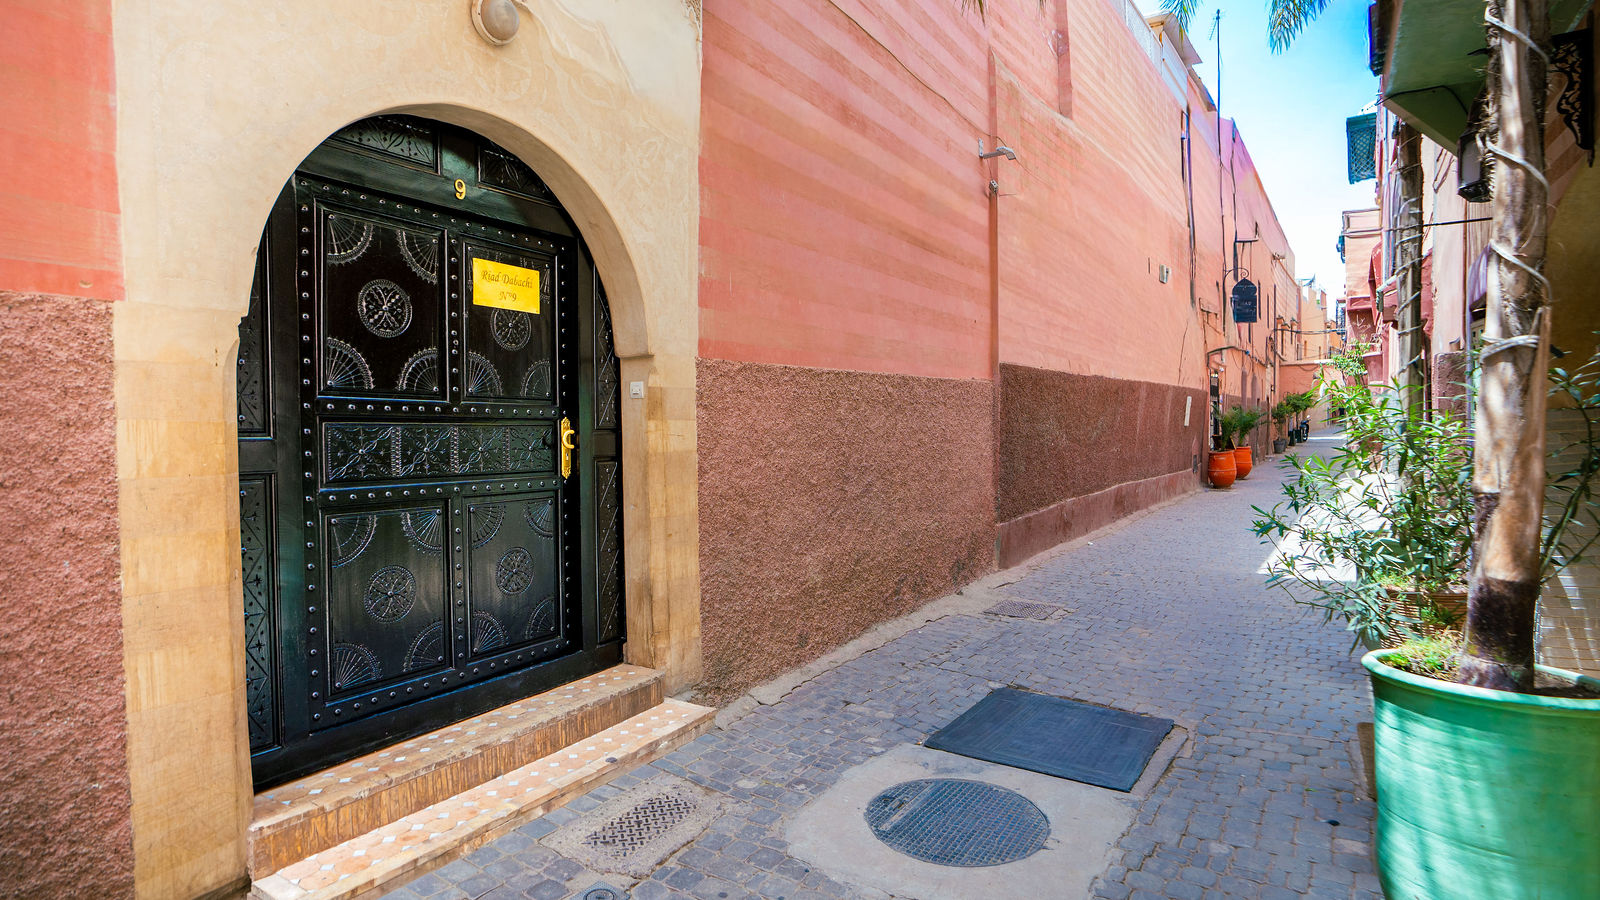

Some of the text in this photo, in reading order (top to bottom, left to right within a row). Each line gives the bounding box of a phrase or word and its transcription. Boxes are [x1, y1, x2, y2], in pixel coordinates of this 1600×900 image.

[455, 178, 466, 200] 9
[481, 270, 533, 289] Riad Dabachi
